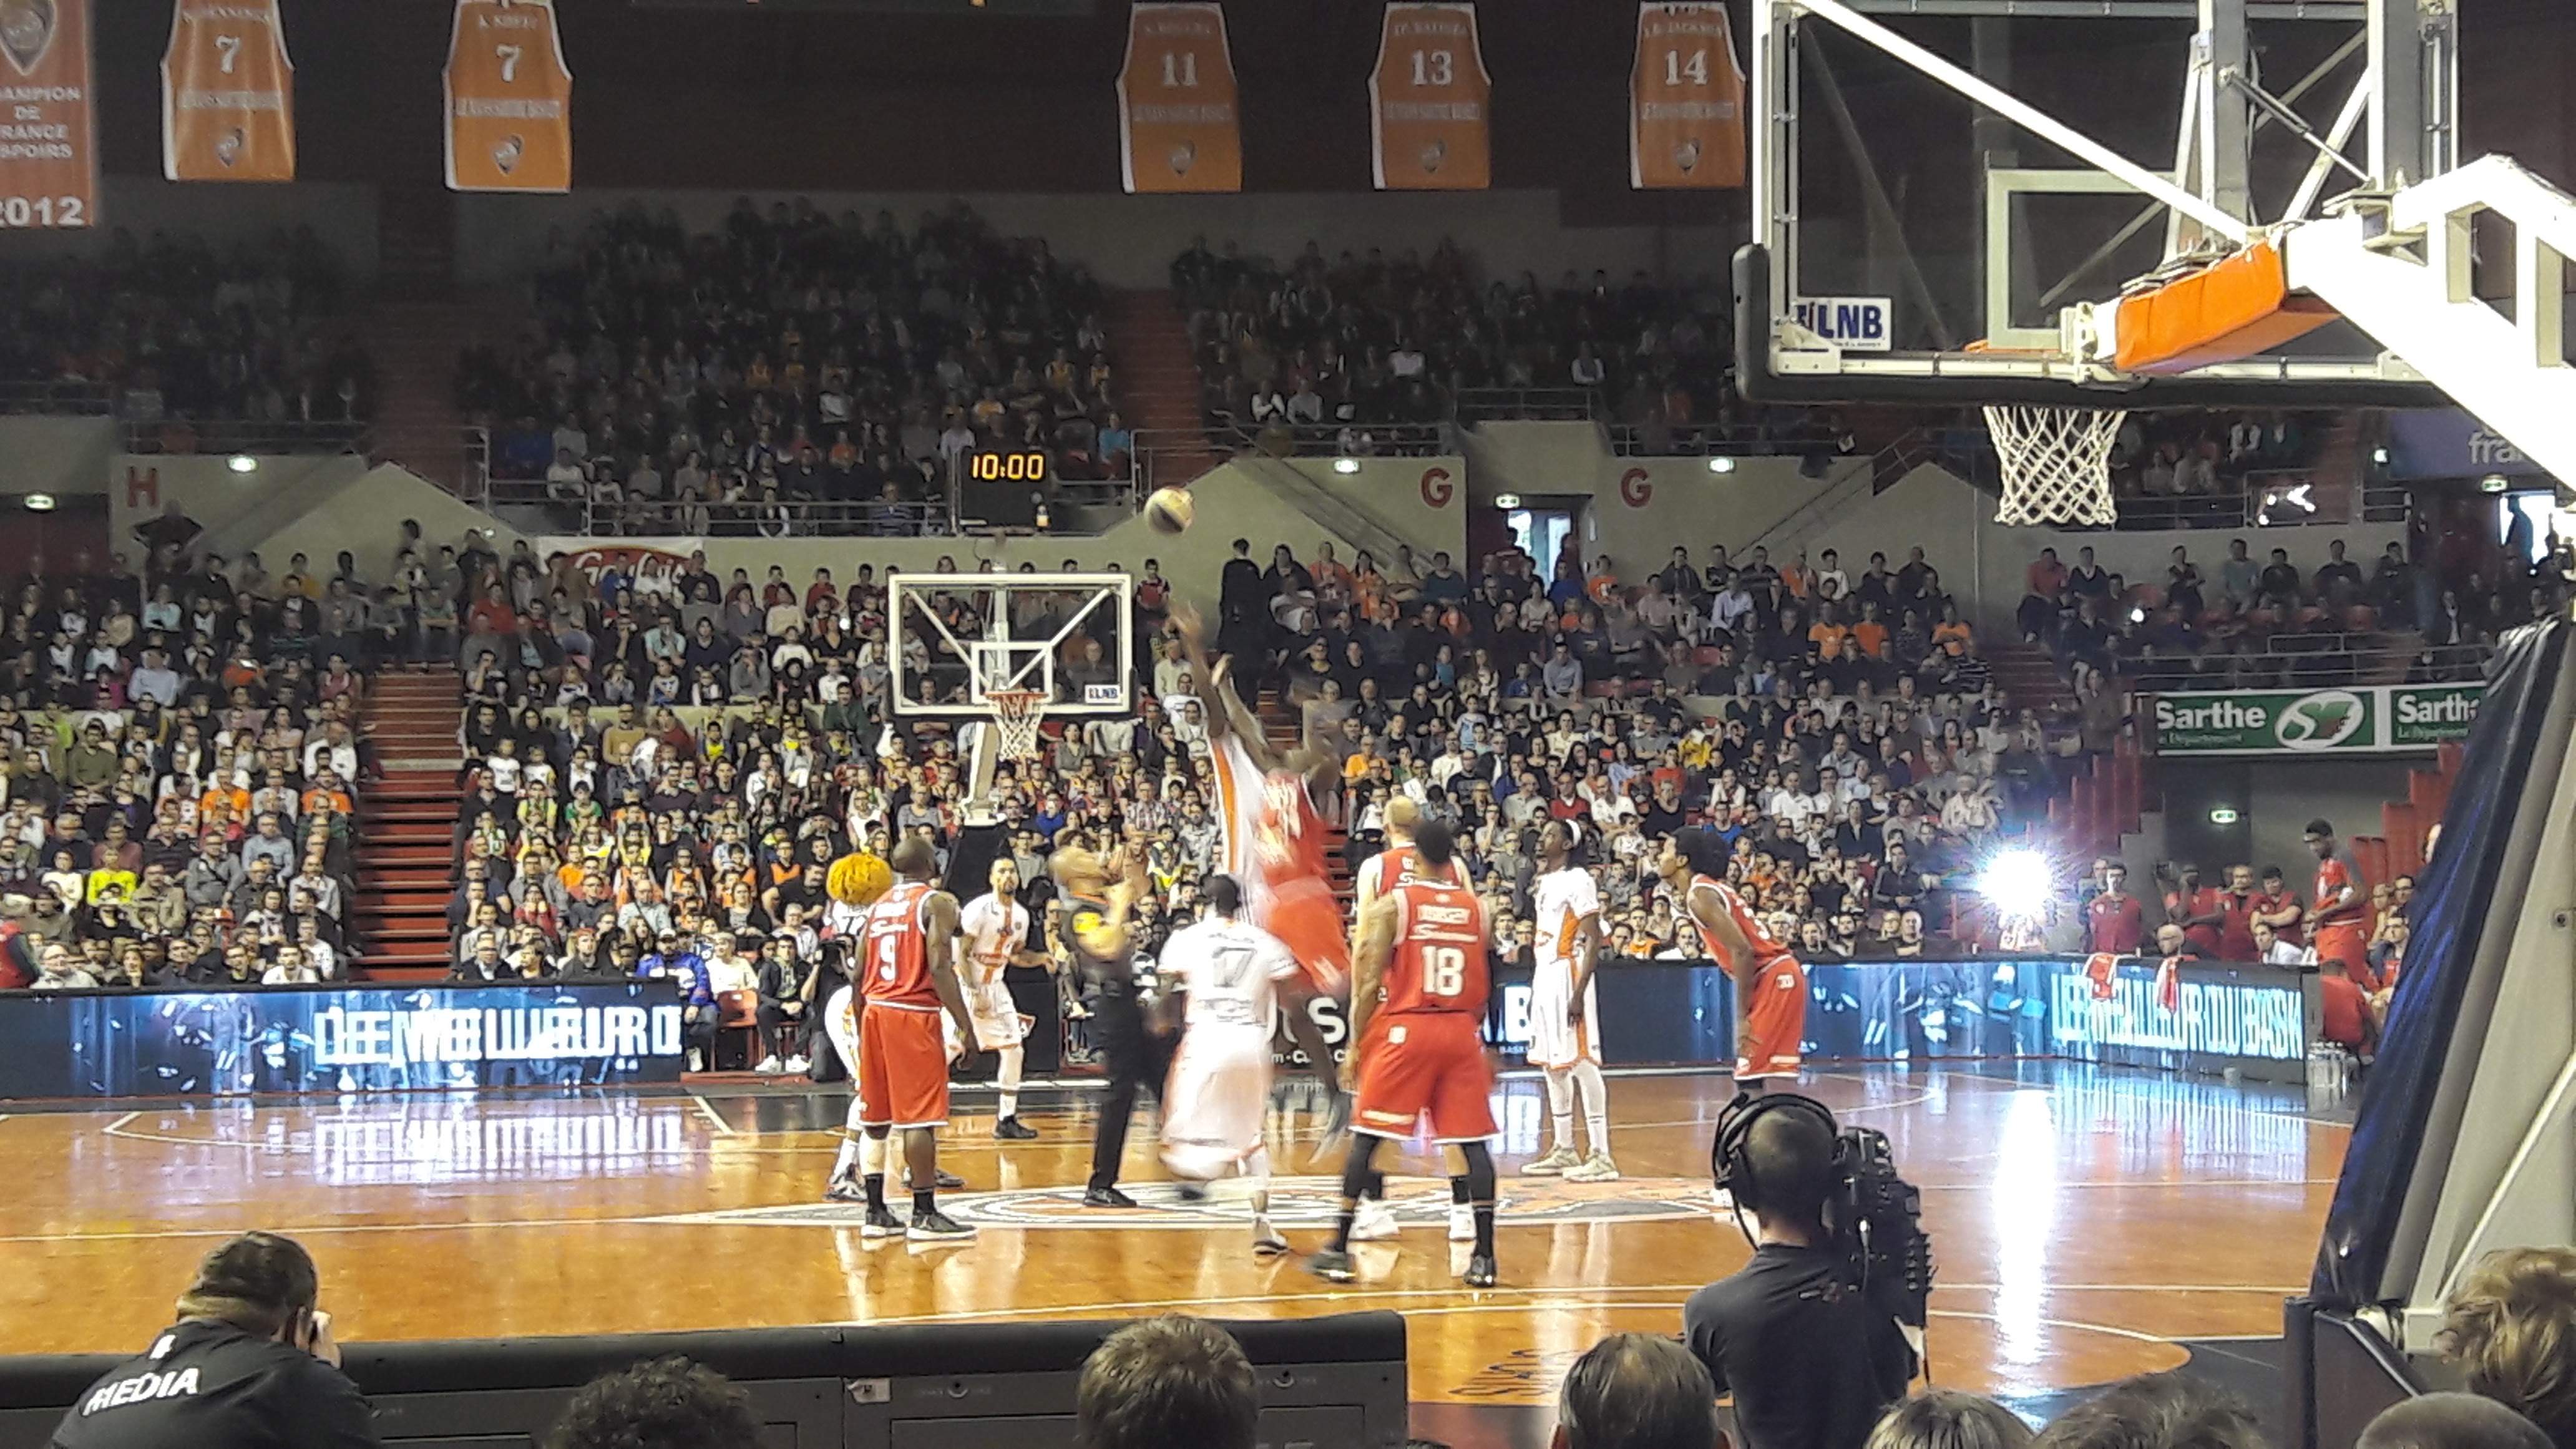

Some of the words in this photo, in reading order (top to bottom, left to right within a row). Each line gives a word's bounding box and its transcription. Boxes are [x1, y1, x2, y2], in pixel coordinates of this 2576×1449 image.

[215, 36, 240, 73] 7
[496, 45, 521, 82] 7
[1163, 52, 1198, 86] 11
[1412, 50, 1453, 85] 13
[1666, 50, 1707, 85] 14
[0, 86, 81, 101] AMPION
[14, 105, 41, 120] DE
[0, 124, 68, 140] RANCE
[0, 143, 72, 159] SPOIRS
[0, 196, 84, 227] 012
[2469, 431, 2524, 464] fra
[972, 454, 1043, 479] 10:00
[127, 466, 157, 508] H
[1421, 467, 1453, 508] G
[1621, 467, 1652, 507] G
[2155, 700, 2267, 729] Sarthe
[880, 935, 896, 981] 9
[1421, 945, 1465, 996] 18
[82, 1368, 199, 1416] MEDIA
